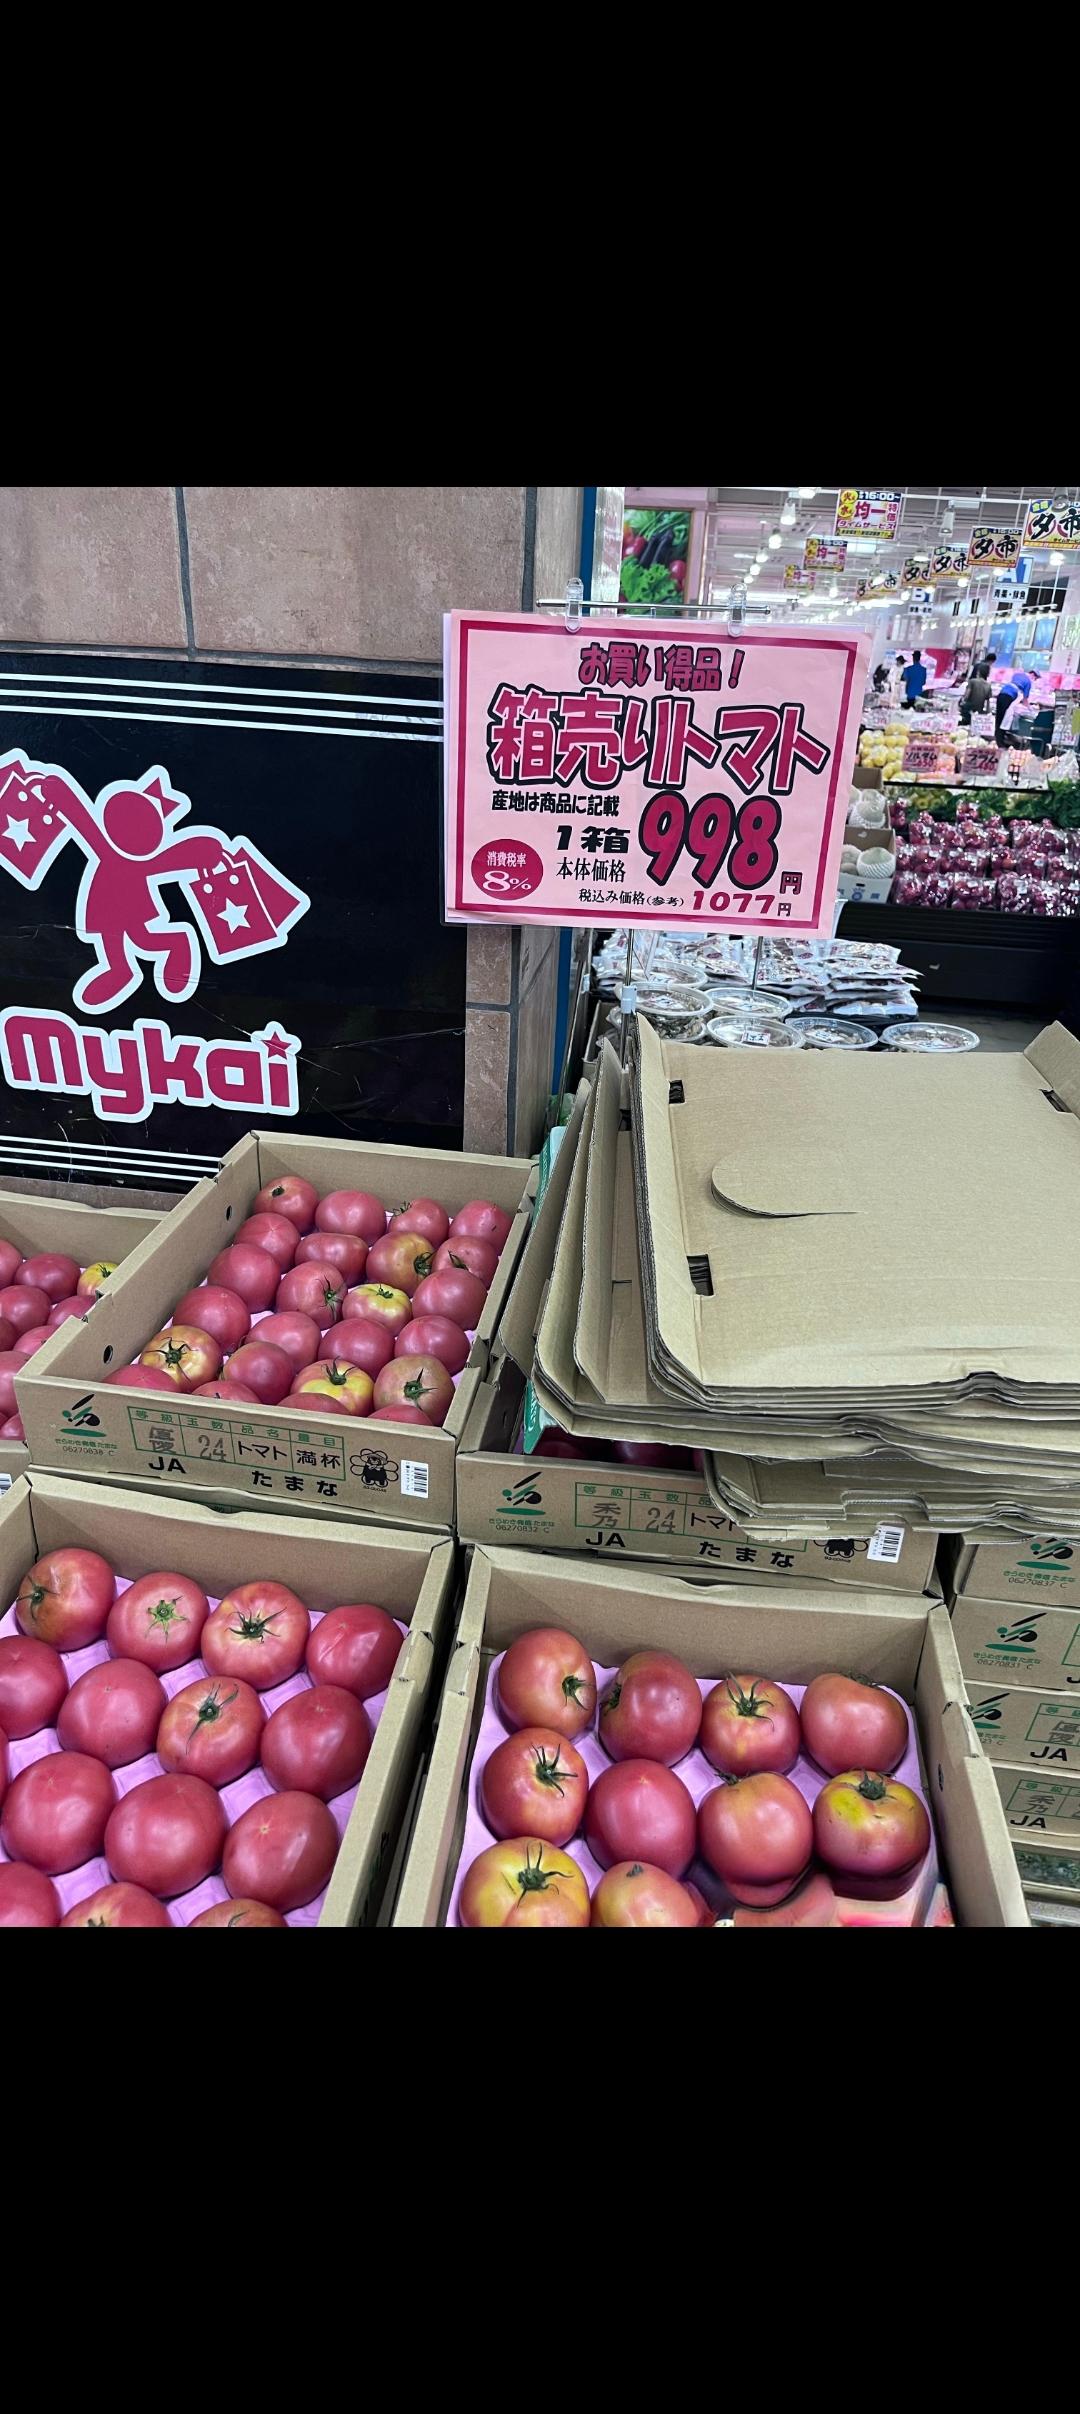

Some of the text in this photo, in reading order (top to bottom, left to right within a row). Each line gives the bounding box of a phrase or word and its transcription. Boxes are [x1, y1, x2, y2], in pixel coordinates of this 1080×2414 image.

[854, 501, 887, 520] 均一
[1031, 507, 1080, 540] 夕市
[974, 534, 1018, 560] 夕市
[486, 683, 830, 794] 箱売りトマト
[491, 789, 620, 817] 産地は商品に記載
[638, 790, 802, 895] 998 円
[487, 851, 527, 867] 消費税率
[556, 857, 626, 883] 本体価格
[483, 870, 532, 892] 8%
[693, 890, 776, 916] 1077
[777, 902, 792, 918] 円
[241, 1424, 280, 1438] 品名
[197, 1434, 227, 1462] 24
[237, 1440, 288, 1461] トマト
[296, 1449, 341, 1470] 満杯
[148, 1455, 338, 1497] JA たまな
[591, 1502, 622, 1528] 秀
[646, 1506, 676, 1533] 24
[585, 1531, 795, 1569] JA たまな
[1029, 1745, 1068, 1762] JA
[1009, 1815, 1047, 1829] JA
